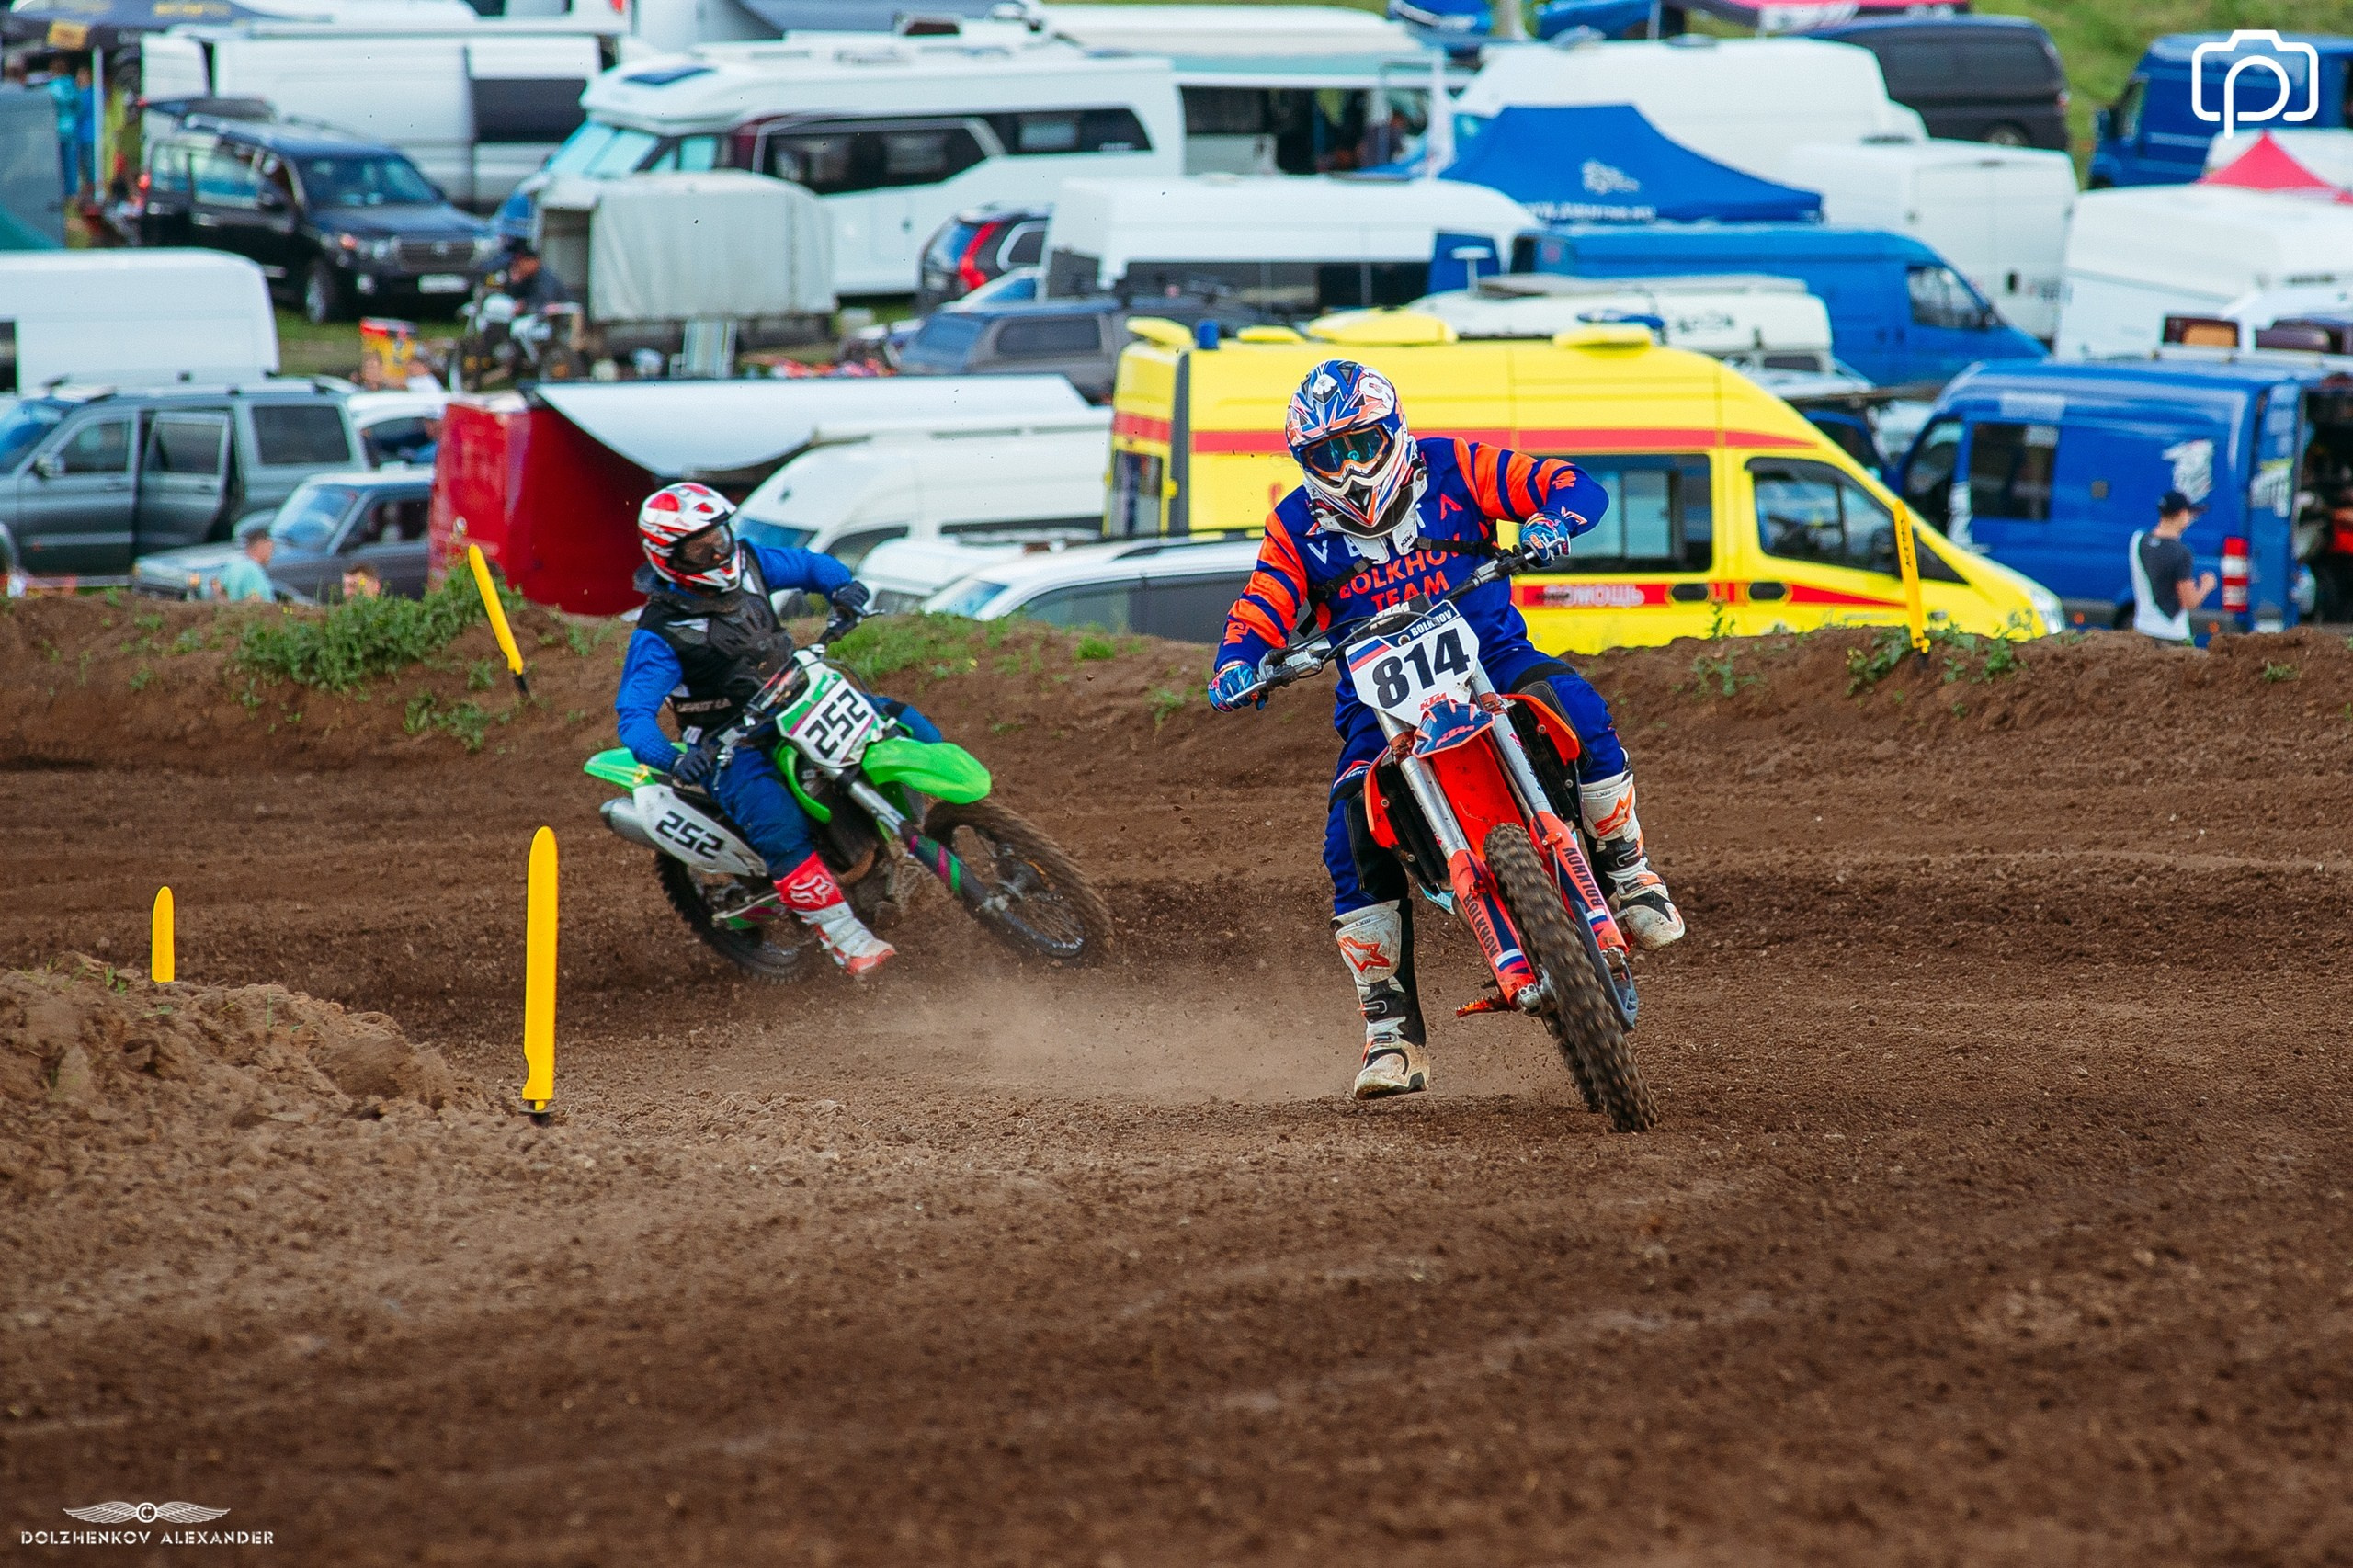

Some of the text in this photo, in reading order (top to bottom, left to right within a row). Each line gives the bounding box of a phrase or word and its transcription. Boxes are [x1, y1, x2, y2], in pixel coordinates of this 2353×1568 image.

[1370, 570, 1450, 610] TEAM
[1371, 627, 1471, 710] 814
[804, 687, 869, 759] 252
[1419, 692, 1448, 711] KTM
[1435, 724, 1475, 748] KTM
[655, 811, 724, 860] 252
[1563, 847, 1605, 907] BOLKHOV
[1463, 894, 1500, 958] BOLKHOV
